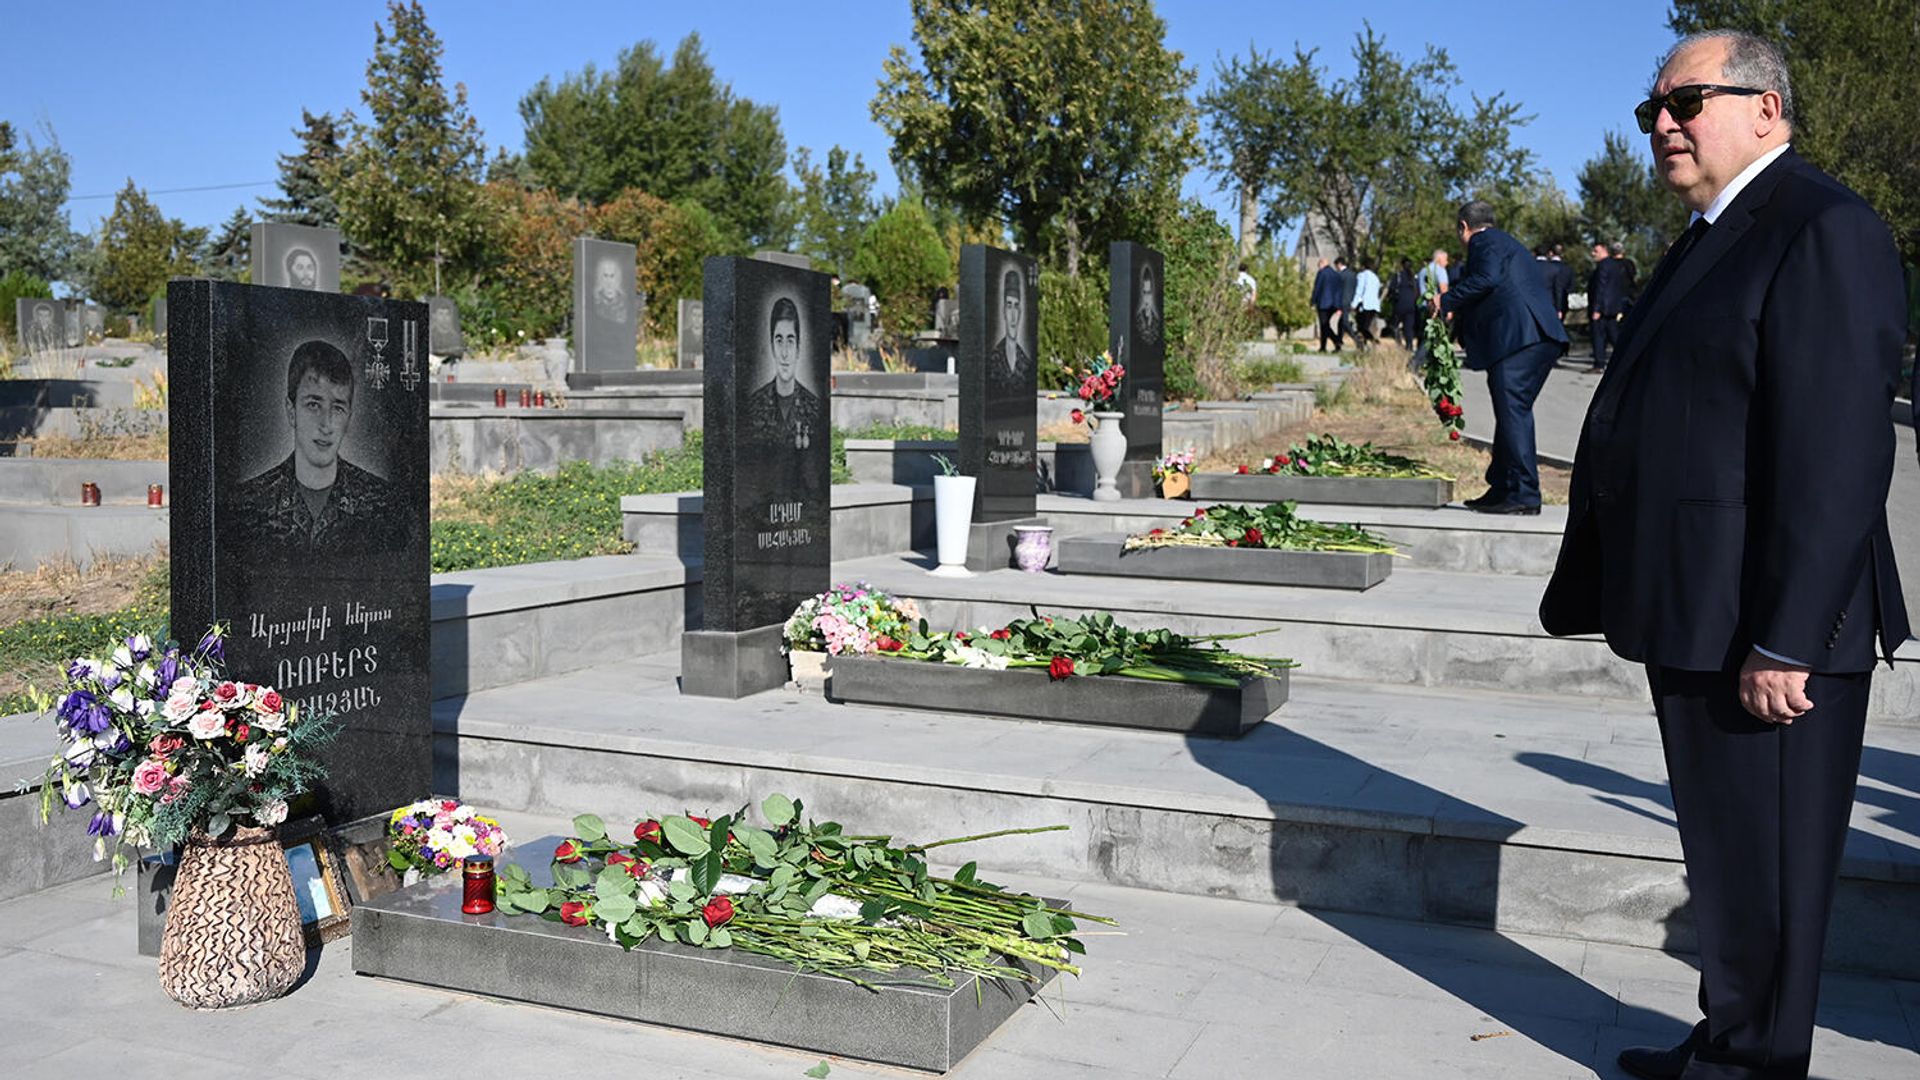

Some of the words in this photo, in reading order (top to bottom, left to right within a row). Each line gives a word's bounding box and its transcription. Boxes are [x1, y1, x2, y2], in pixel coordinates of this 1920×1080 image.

[770, 502, 804, 525] ԱԴԱՄ
[758, 528, 812, 550] ՍԱՀԱԿՅԱՆ
[249, 606, 331, 648] Արցախի
[345, 601, 392, 634] հերոս
[277, 645, 378, 690] ՌՈԲԵՐՏ
